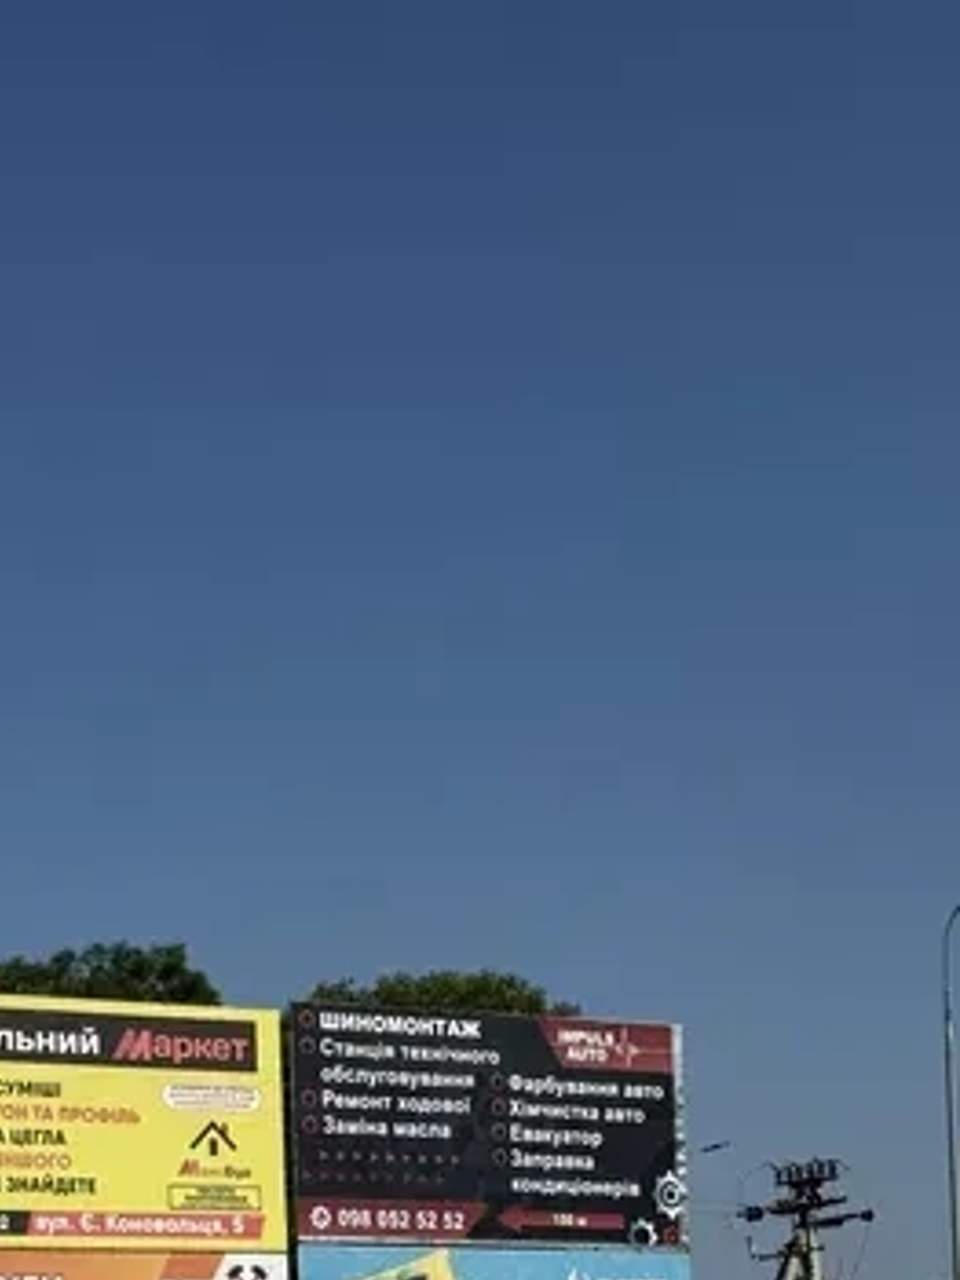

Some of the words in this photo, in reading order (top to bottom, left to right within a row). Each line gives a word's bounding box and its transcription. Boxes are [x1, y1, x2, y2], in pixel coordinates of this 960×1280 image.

[319, 1012, 482, 1039] ШИНОМОНТАЖ
[113, 1028, 249, 1064] Маркет
[319, 1037, 395, 1060] Станція
[399, 1045, 500, 1065] технічного
[319, 1065, 475, 1090] обслуговування
[510, 1074, 619, 1098] Фарбування
[623, 1084, 664, 1099] авто
[322, 1089, 391, 1110] Ремонт
[396, 1096, 471, 1114] ходової
[510, 1099, 599, 1121] Хімчистка
[604, 1107, 646, 1123] авто
[33, 1105, 54, 1121] ТА
[58, 1107, 141, 1125] ПРОФІЛЬ
[322, 1115, 388, 1136] Заміна
[392, 1122, 452, 1139] масла
[9, 1129, 67, 1147] ЦЕГЛА
[510, 1123, 603, 1147] Евакуатор
[510, 1149, 595, 1171] Заправка
[6, 1174, 96, 1196] ЗНАЙДЕТЕ
[416, 1210, 437, 1230] 52
[443, 1210, 464, 1231] 52
